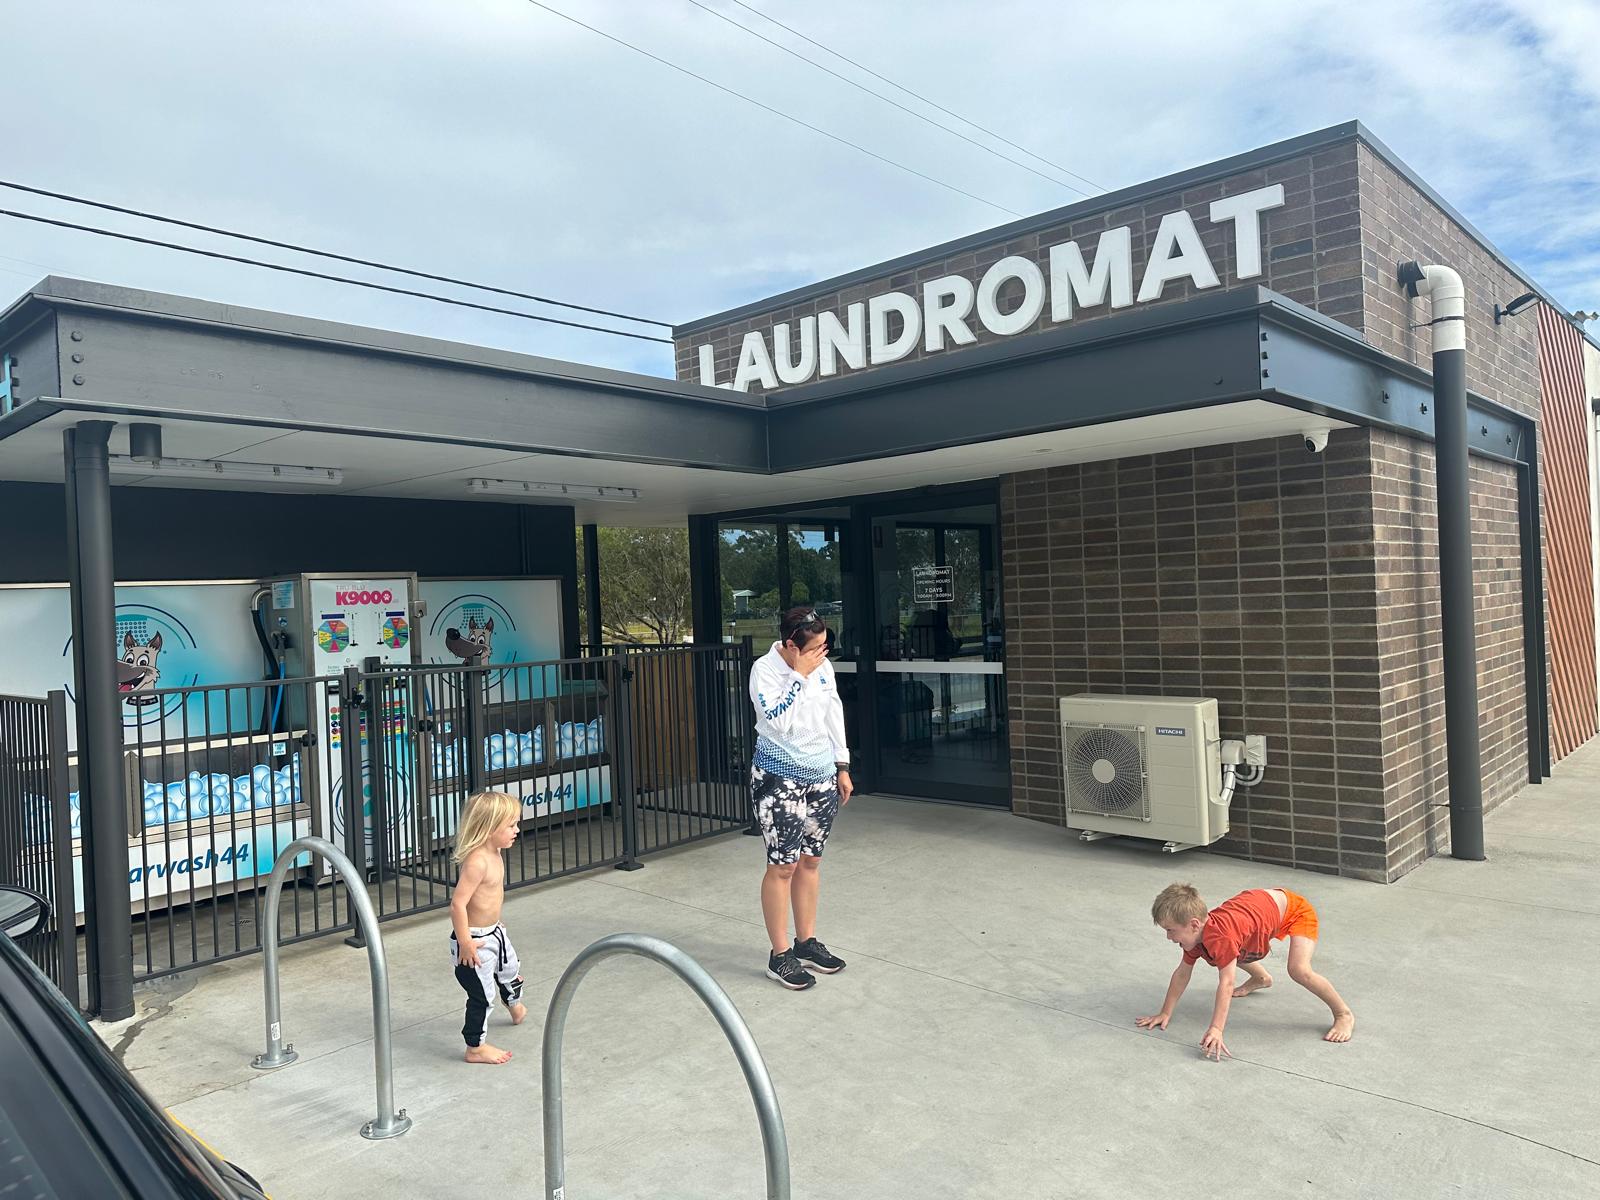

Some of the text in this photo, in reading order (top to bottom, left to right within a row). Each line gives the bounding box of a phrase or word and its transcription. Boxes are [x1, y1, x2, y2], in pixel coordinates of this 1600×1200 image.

[699, 184, 1285, 392] LAUNDROMAT
[336, 591, 392, 605] K9000
[128, 843, 249, 884] arwash44
